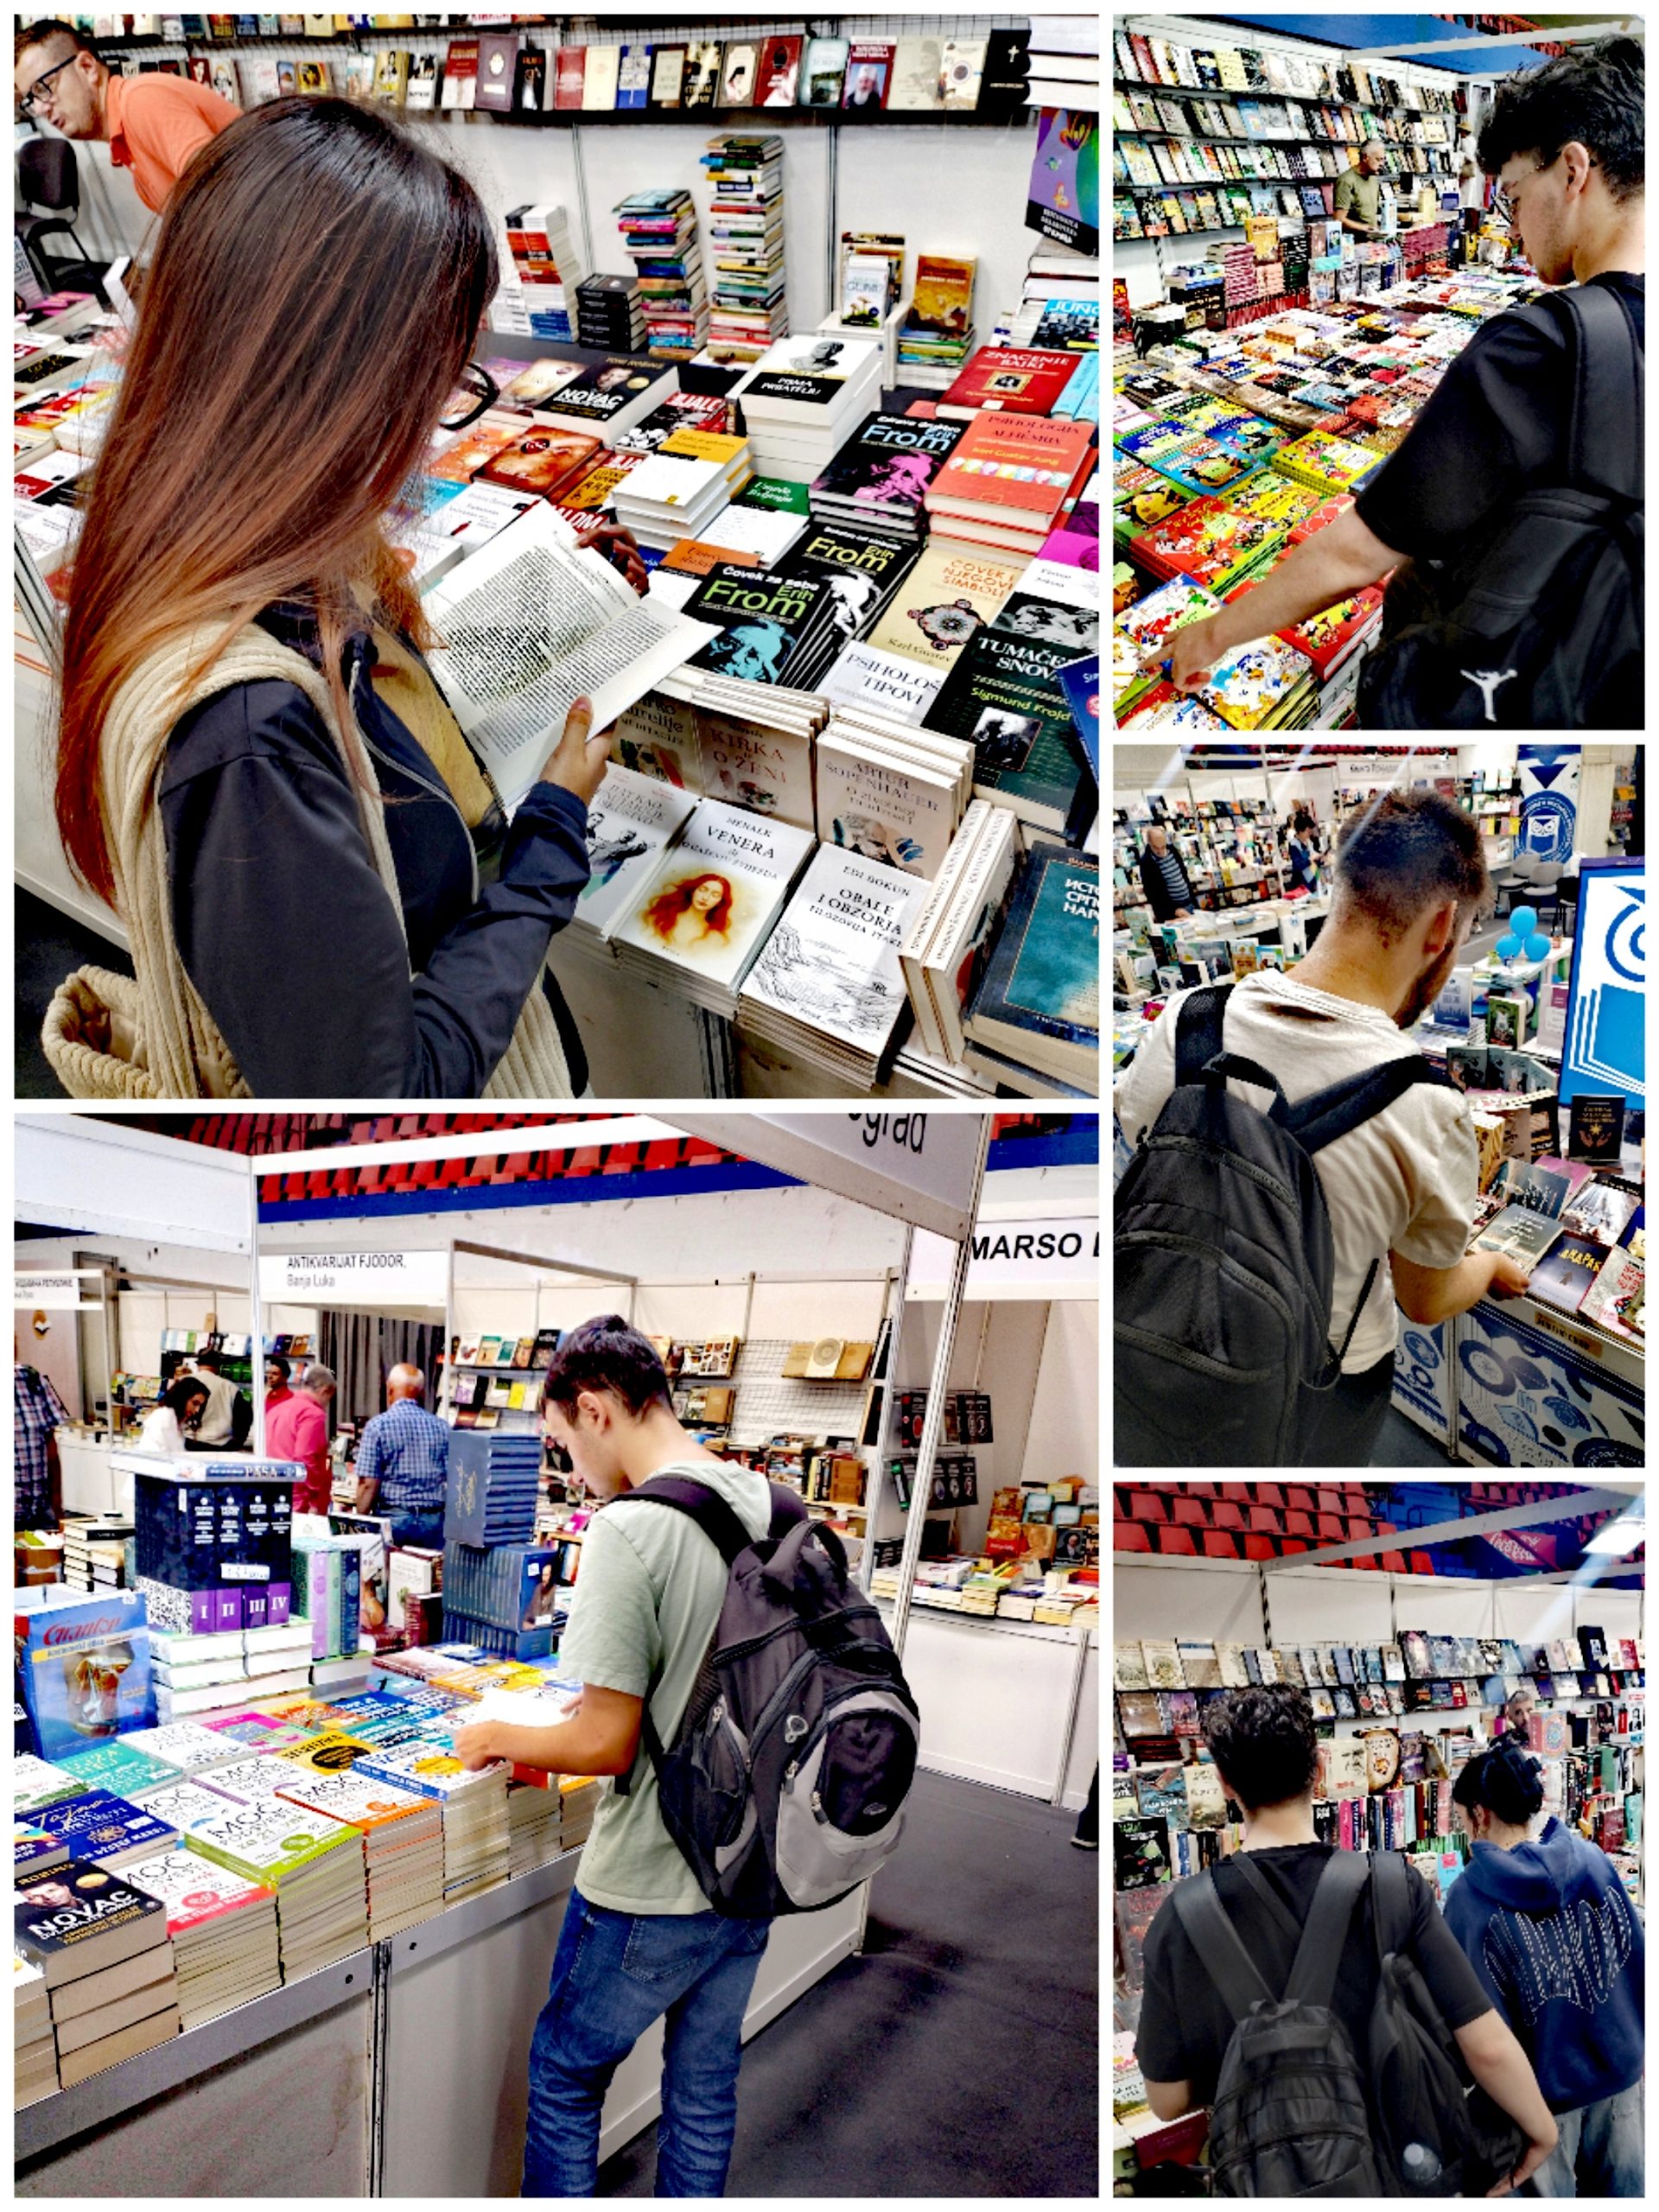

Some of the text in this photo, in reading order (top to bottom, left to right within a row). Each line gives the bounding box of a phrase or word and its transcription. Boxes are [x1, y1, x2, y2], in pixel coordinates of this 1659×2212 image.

[557, 389, 625, 405] NOVAC
[861, 424, 950, 451] From
[806, 537, 887, 572] From
[722, 566, 764, 582] Čovek
[943, 568, 1014, 591] NJEGOVI
[703, 580, 807, 620] From
[777, 584, 815, 601] Erih
[977, 637, 1071, 668] TUMAČE
[864, 675, 924, 706] TIPOVI
[970, 687, 1031, 710] Sigmund
[709, 727, 785, 762] KIRKA
[707, 825, 775, 860] VENERA
[817, 893, 902, 935] I OBZORJA
[839, 888, 894, 916] OBALE
[971, 1233, 1082, 1260] MARSO
[287, 1255, 357, 1268] ANTIKVARIJAT
[287, 1274, 335, 1289] Banja Luka
[200, 1605, 208, 1619] I
[222, 1603, 235, 1617] II
[249, 1599, 266, 1613] III
[271, 1596, 288, 1611] IV
[28, 1891, 132, 1936] NOVAC
